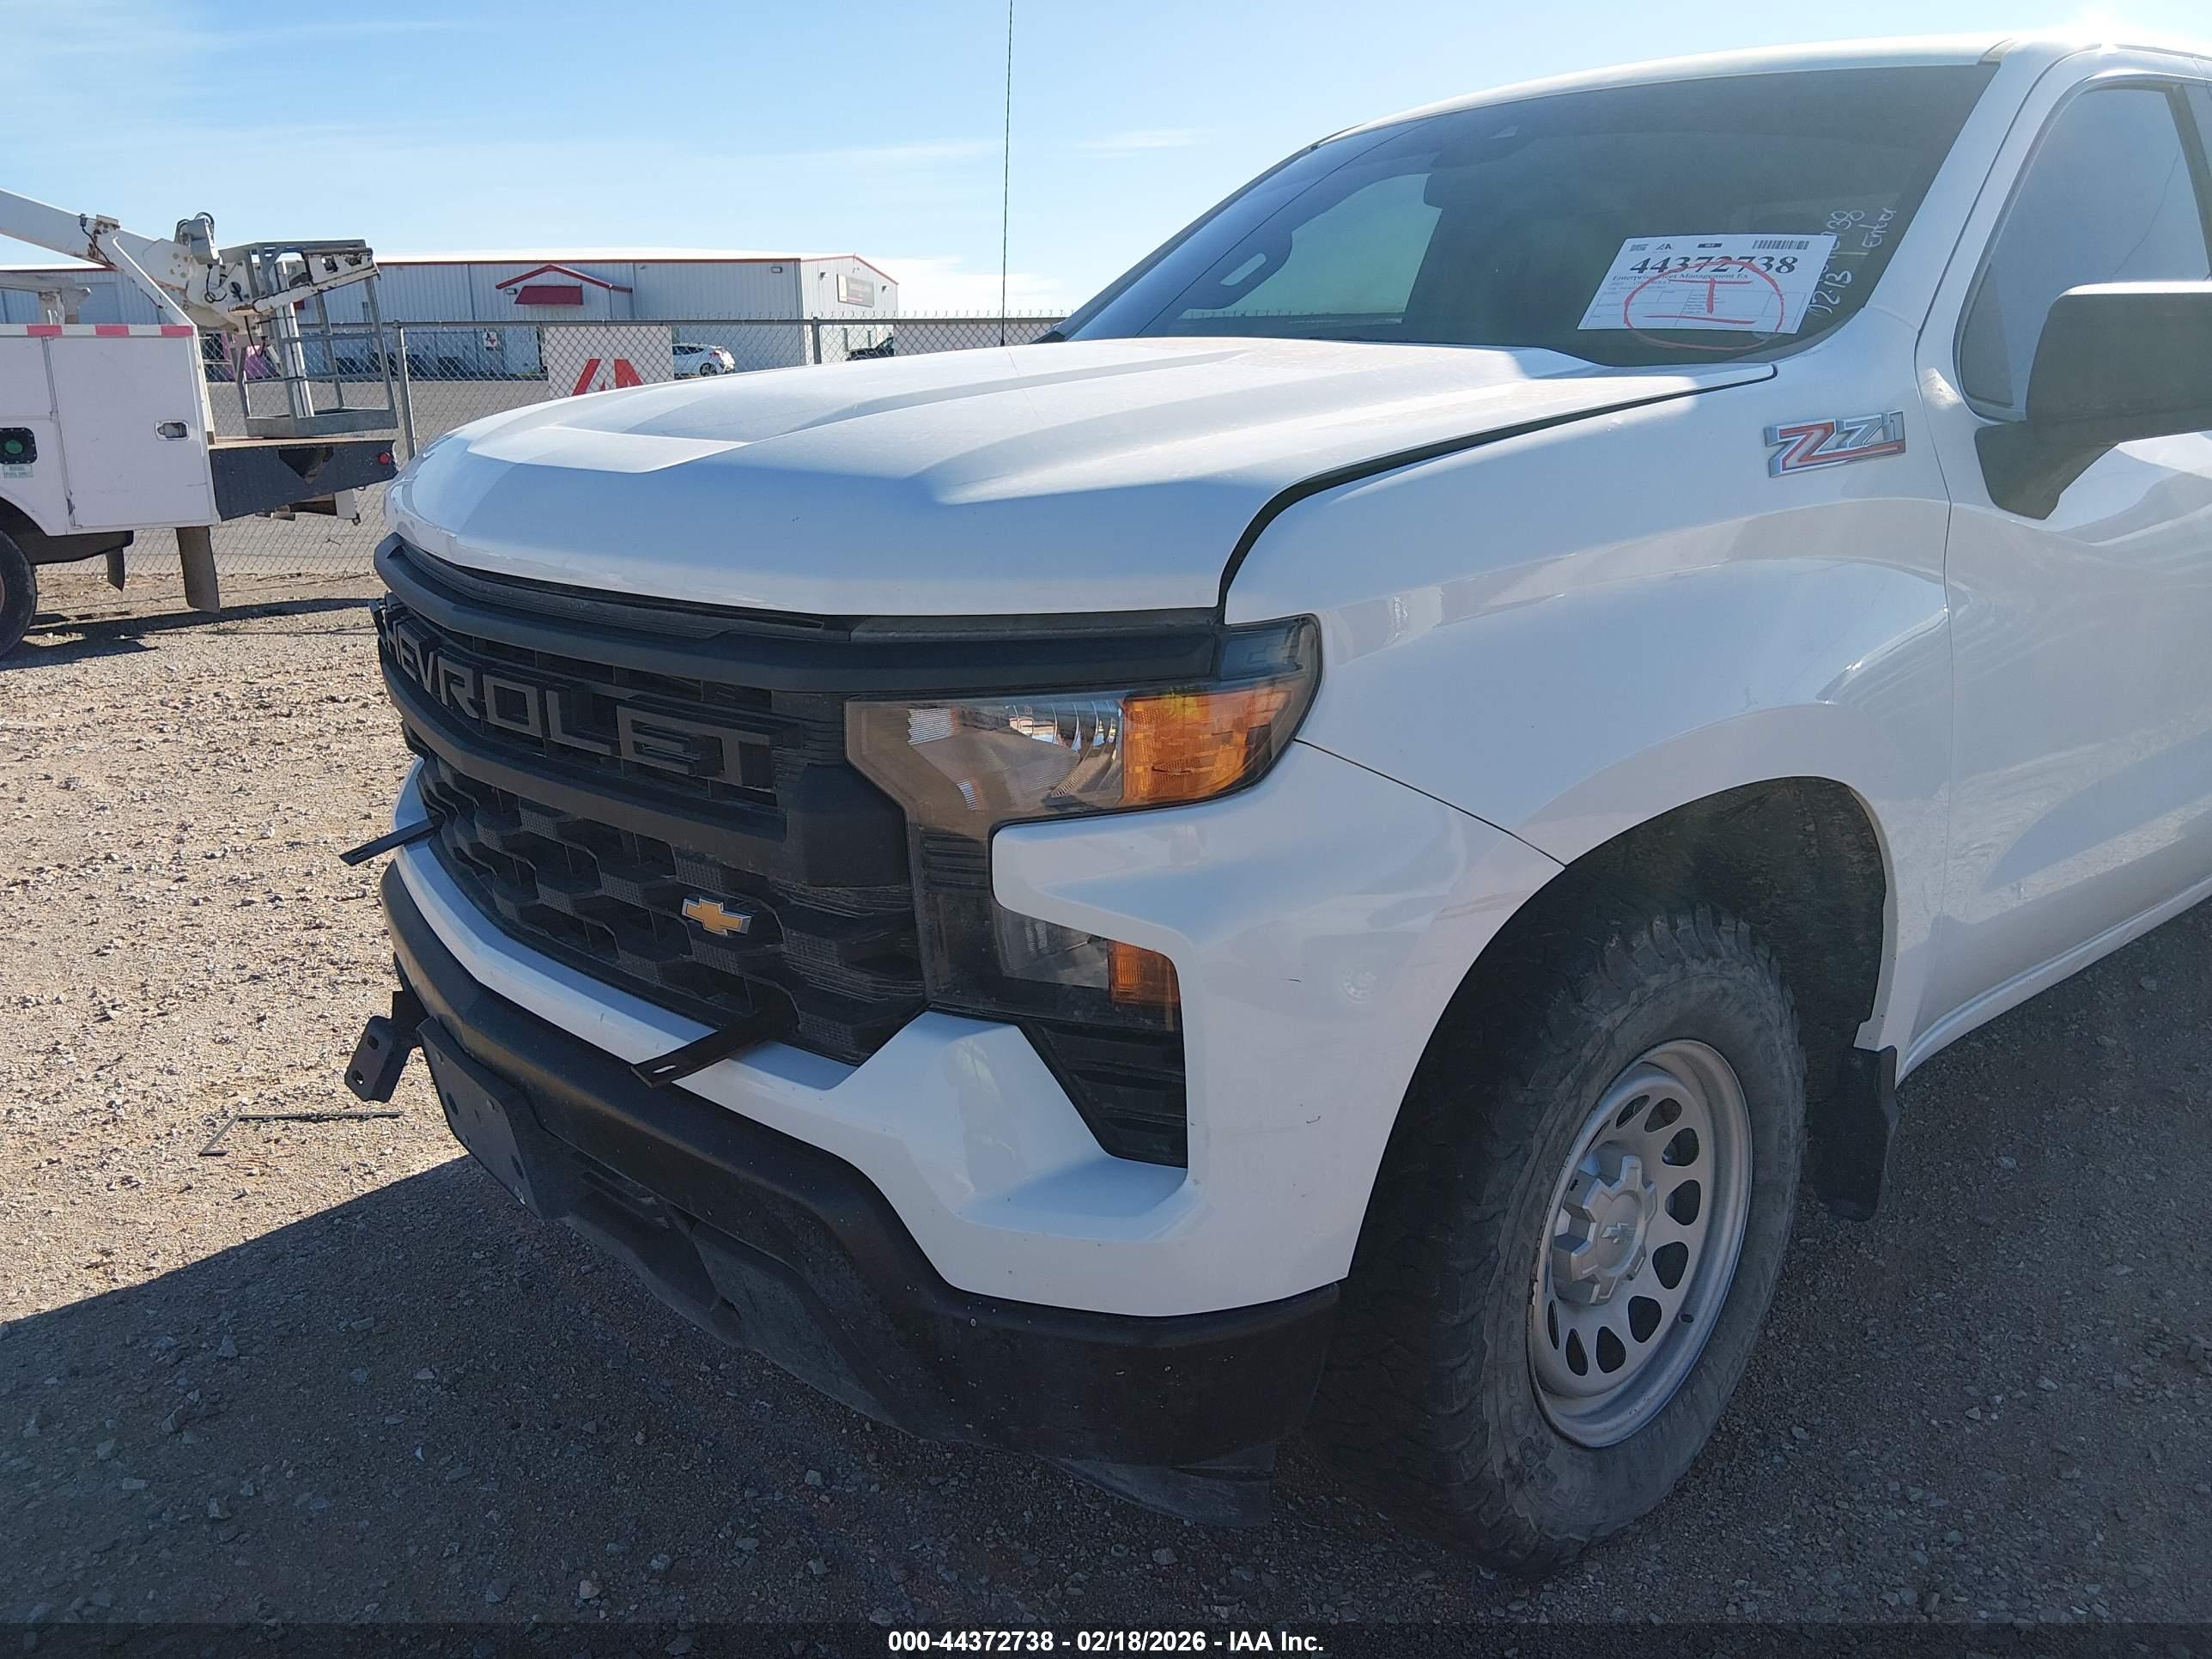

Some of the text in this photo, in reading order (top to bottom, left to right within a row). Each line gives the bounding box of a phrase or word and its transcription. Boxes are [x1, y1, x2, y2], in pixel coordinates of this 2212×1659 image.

[1629, 256, 1799, 273] 44372738
[1679, 273, 1735, 282] Management
[1764, 409, 1906, 478] Z71
